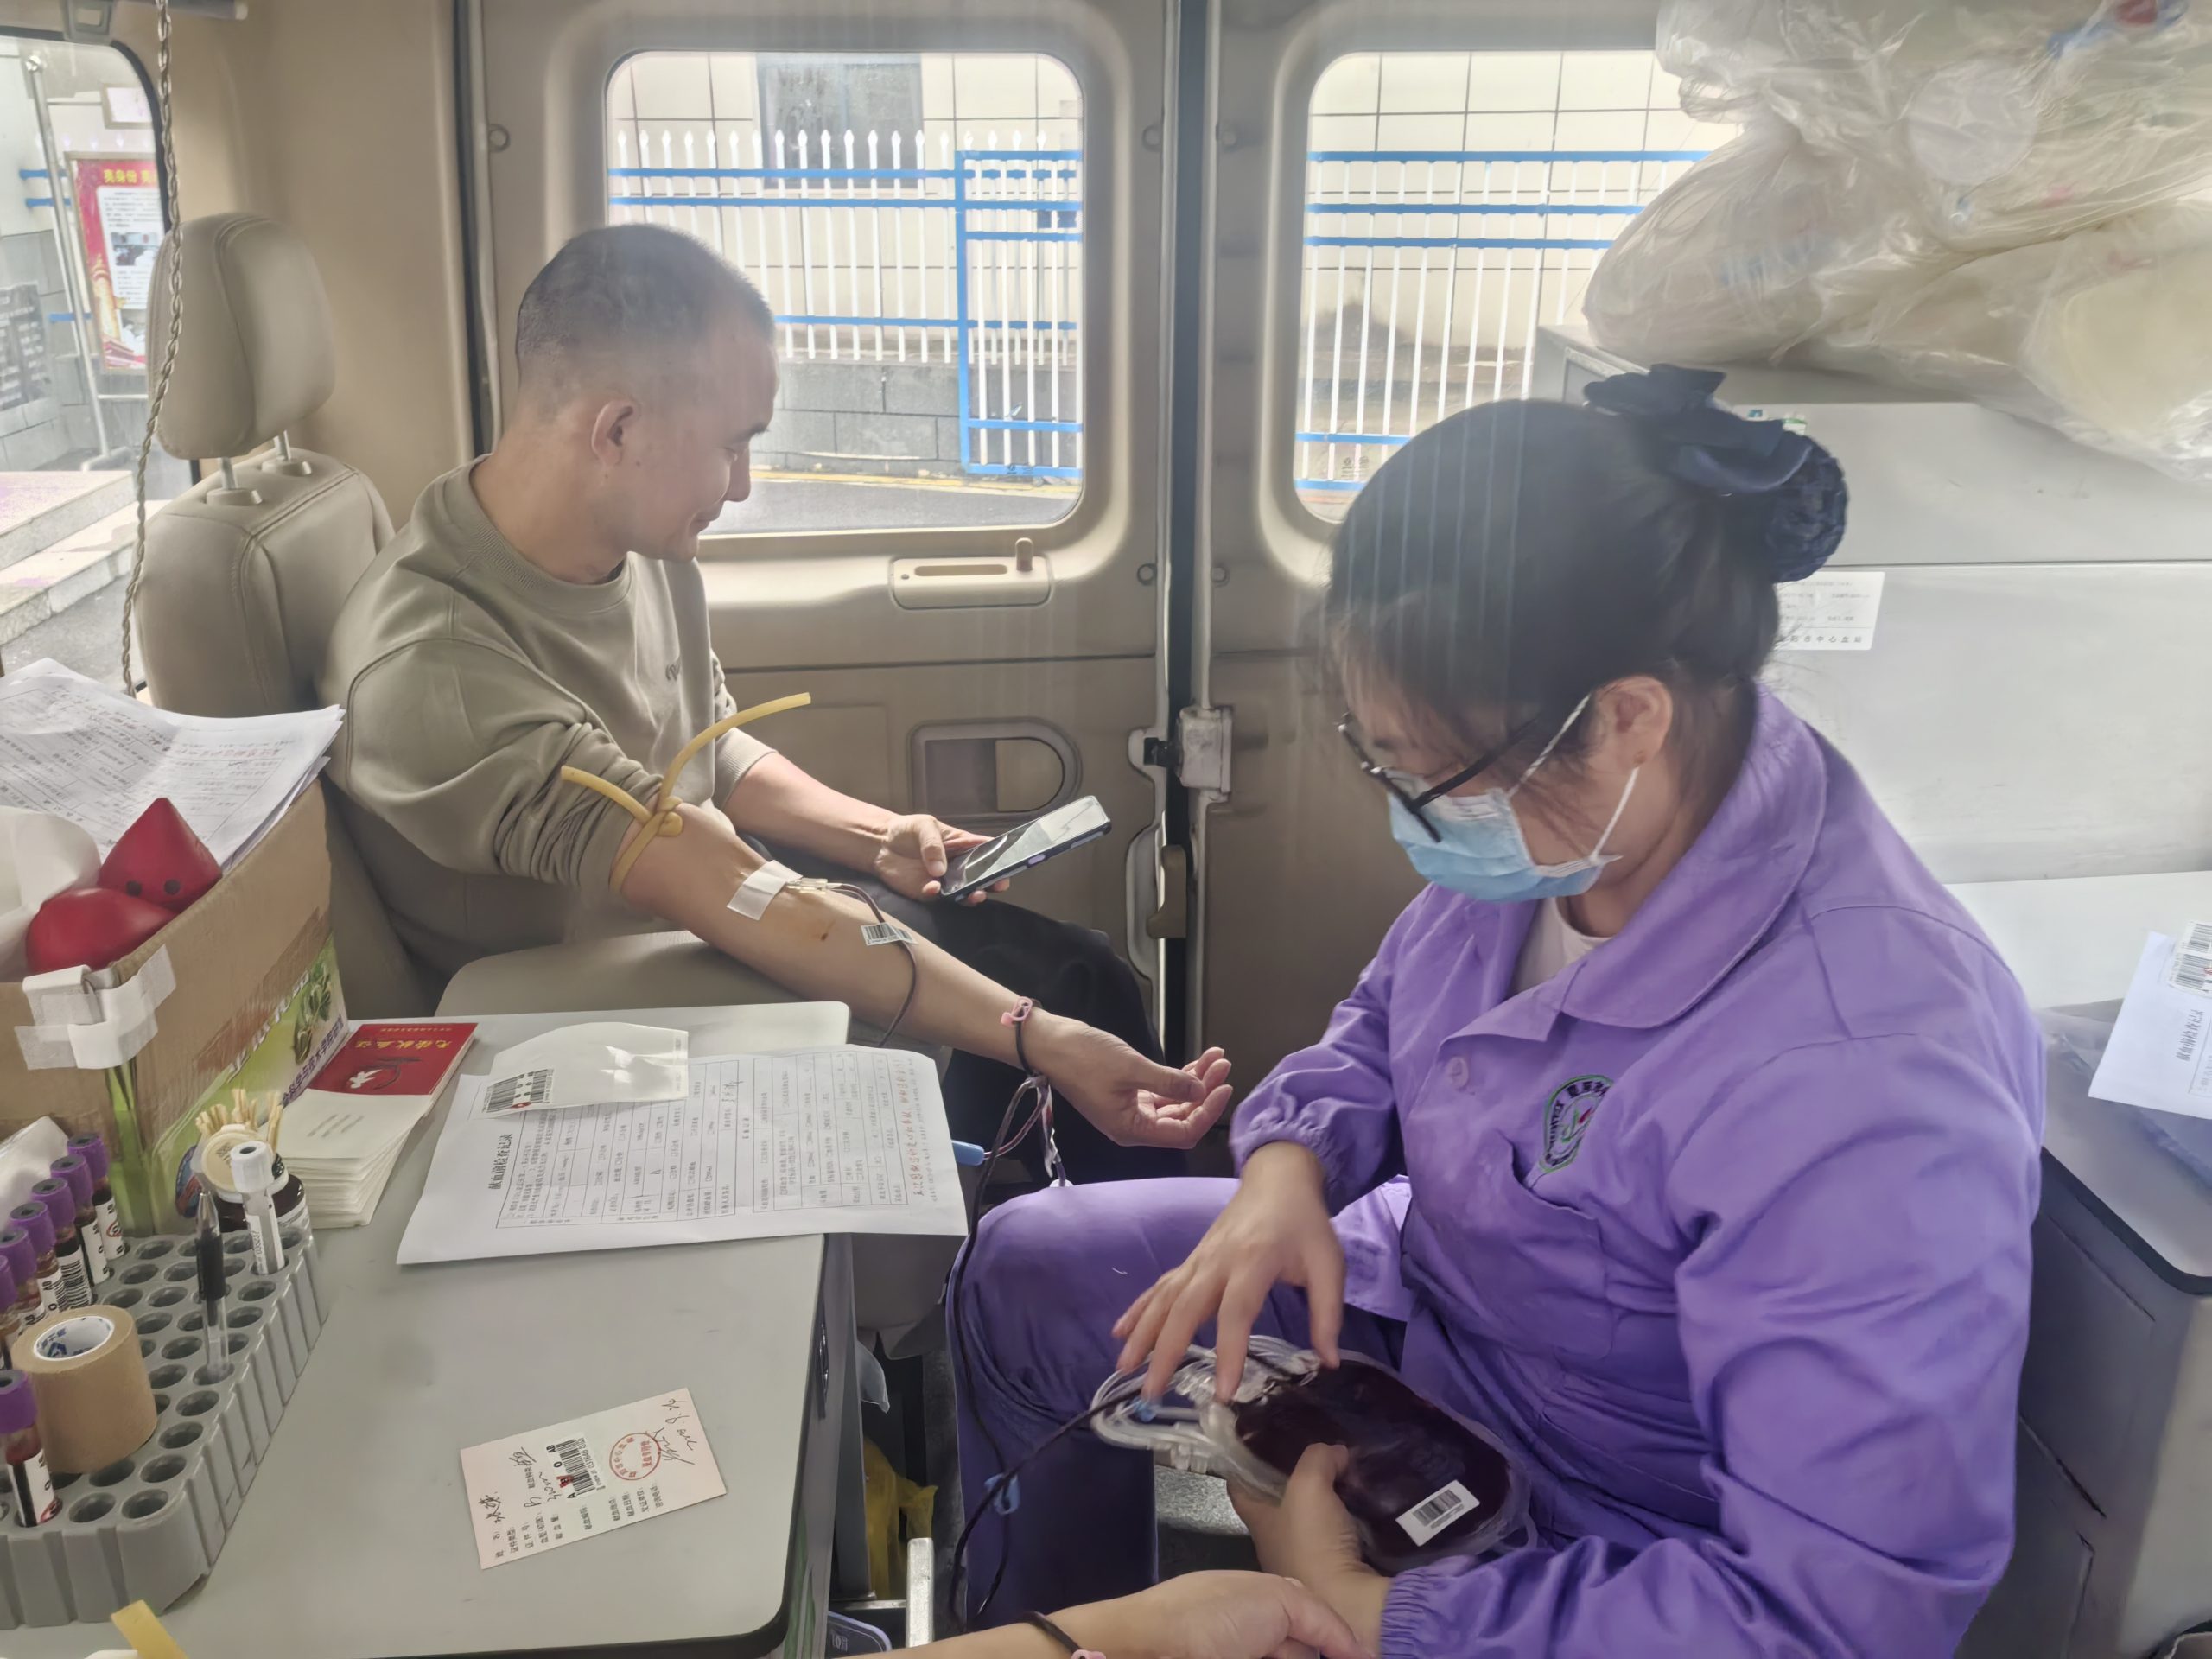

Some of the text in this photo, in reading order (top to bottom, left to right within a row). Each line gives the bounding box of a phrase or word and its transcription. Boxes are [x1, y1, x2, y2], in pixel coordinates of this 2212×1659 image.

[488, 1133, 513, 1191] 献血前检查记录
[546, 1444, 556, 1453] AB
